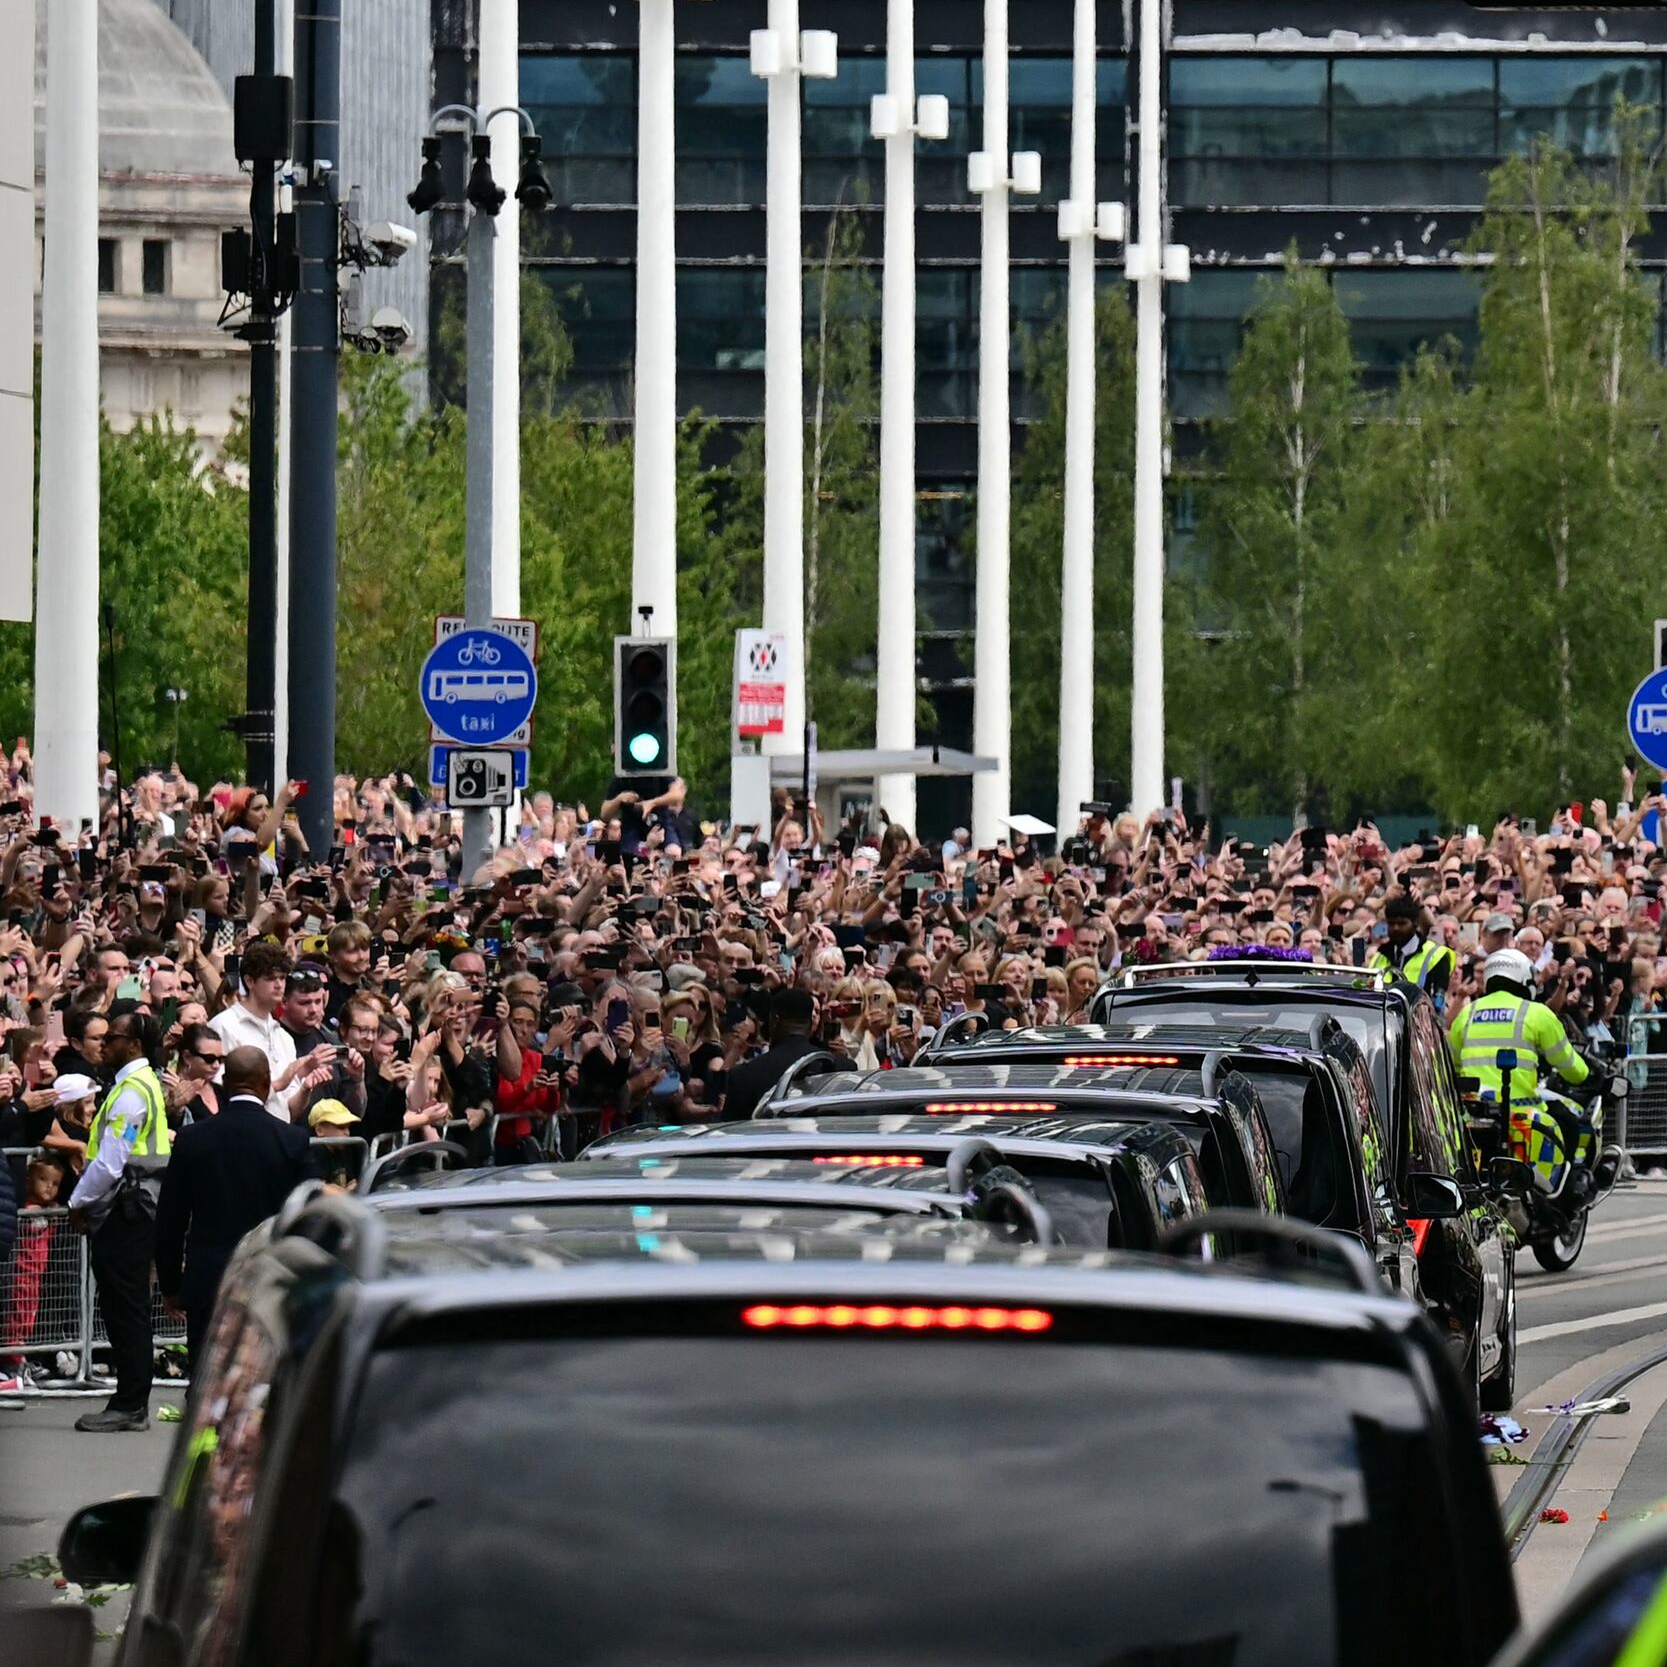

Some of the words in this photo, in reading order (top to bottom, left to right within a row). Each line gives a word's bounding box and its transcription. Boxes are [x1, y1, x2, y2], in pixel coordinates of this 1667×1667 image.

[442, 621, 467, 635] RE
[461, 713, 495, 732] taxi
[1474, 1009, 1514, 1021] POLICE
